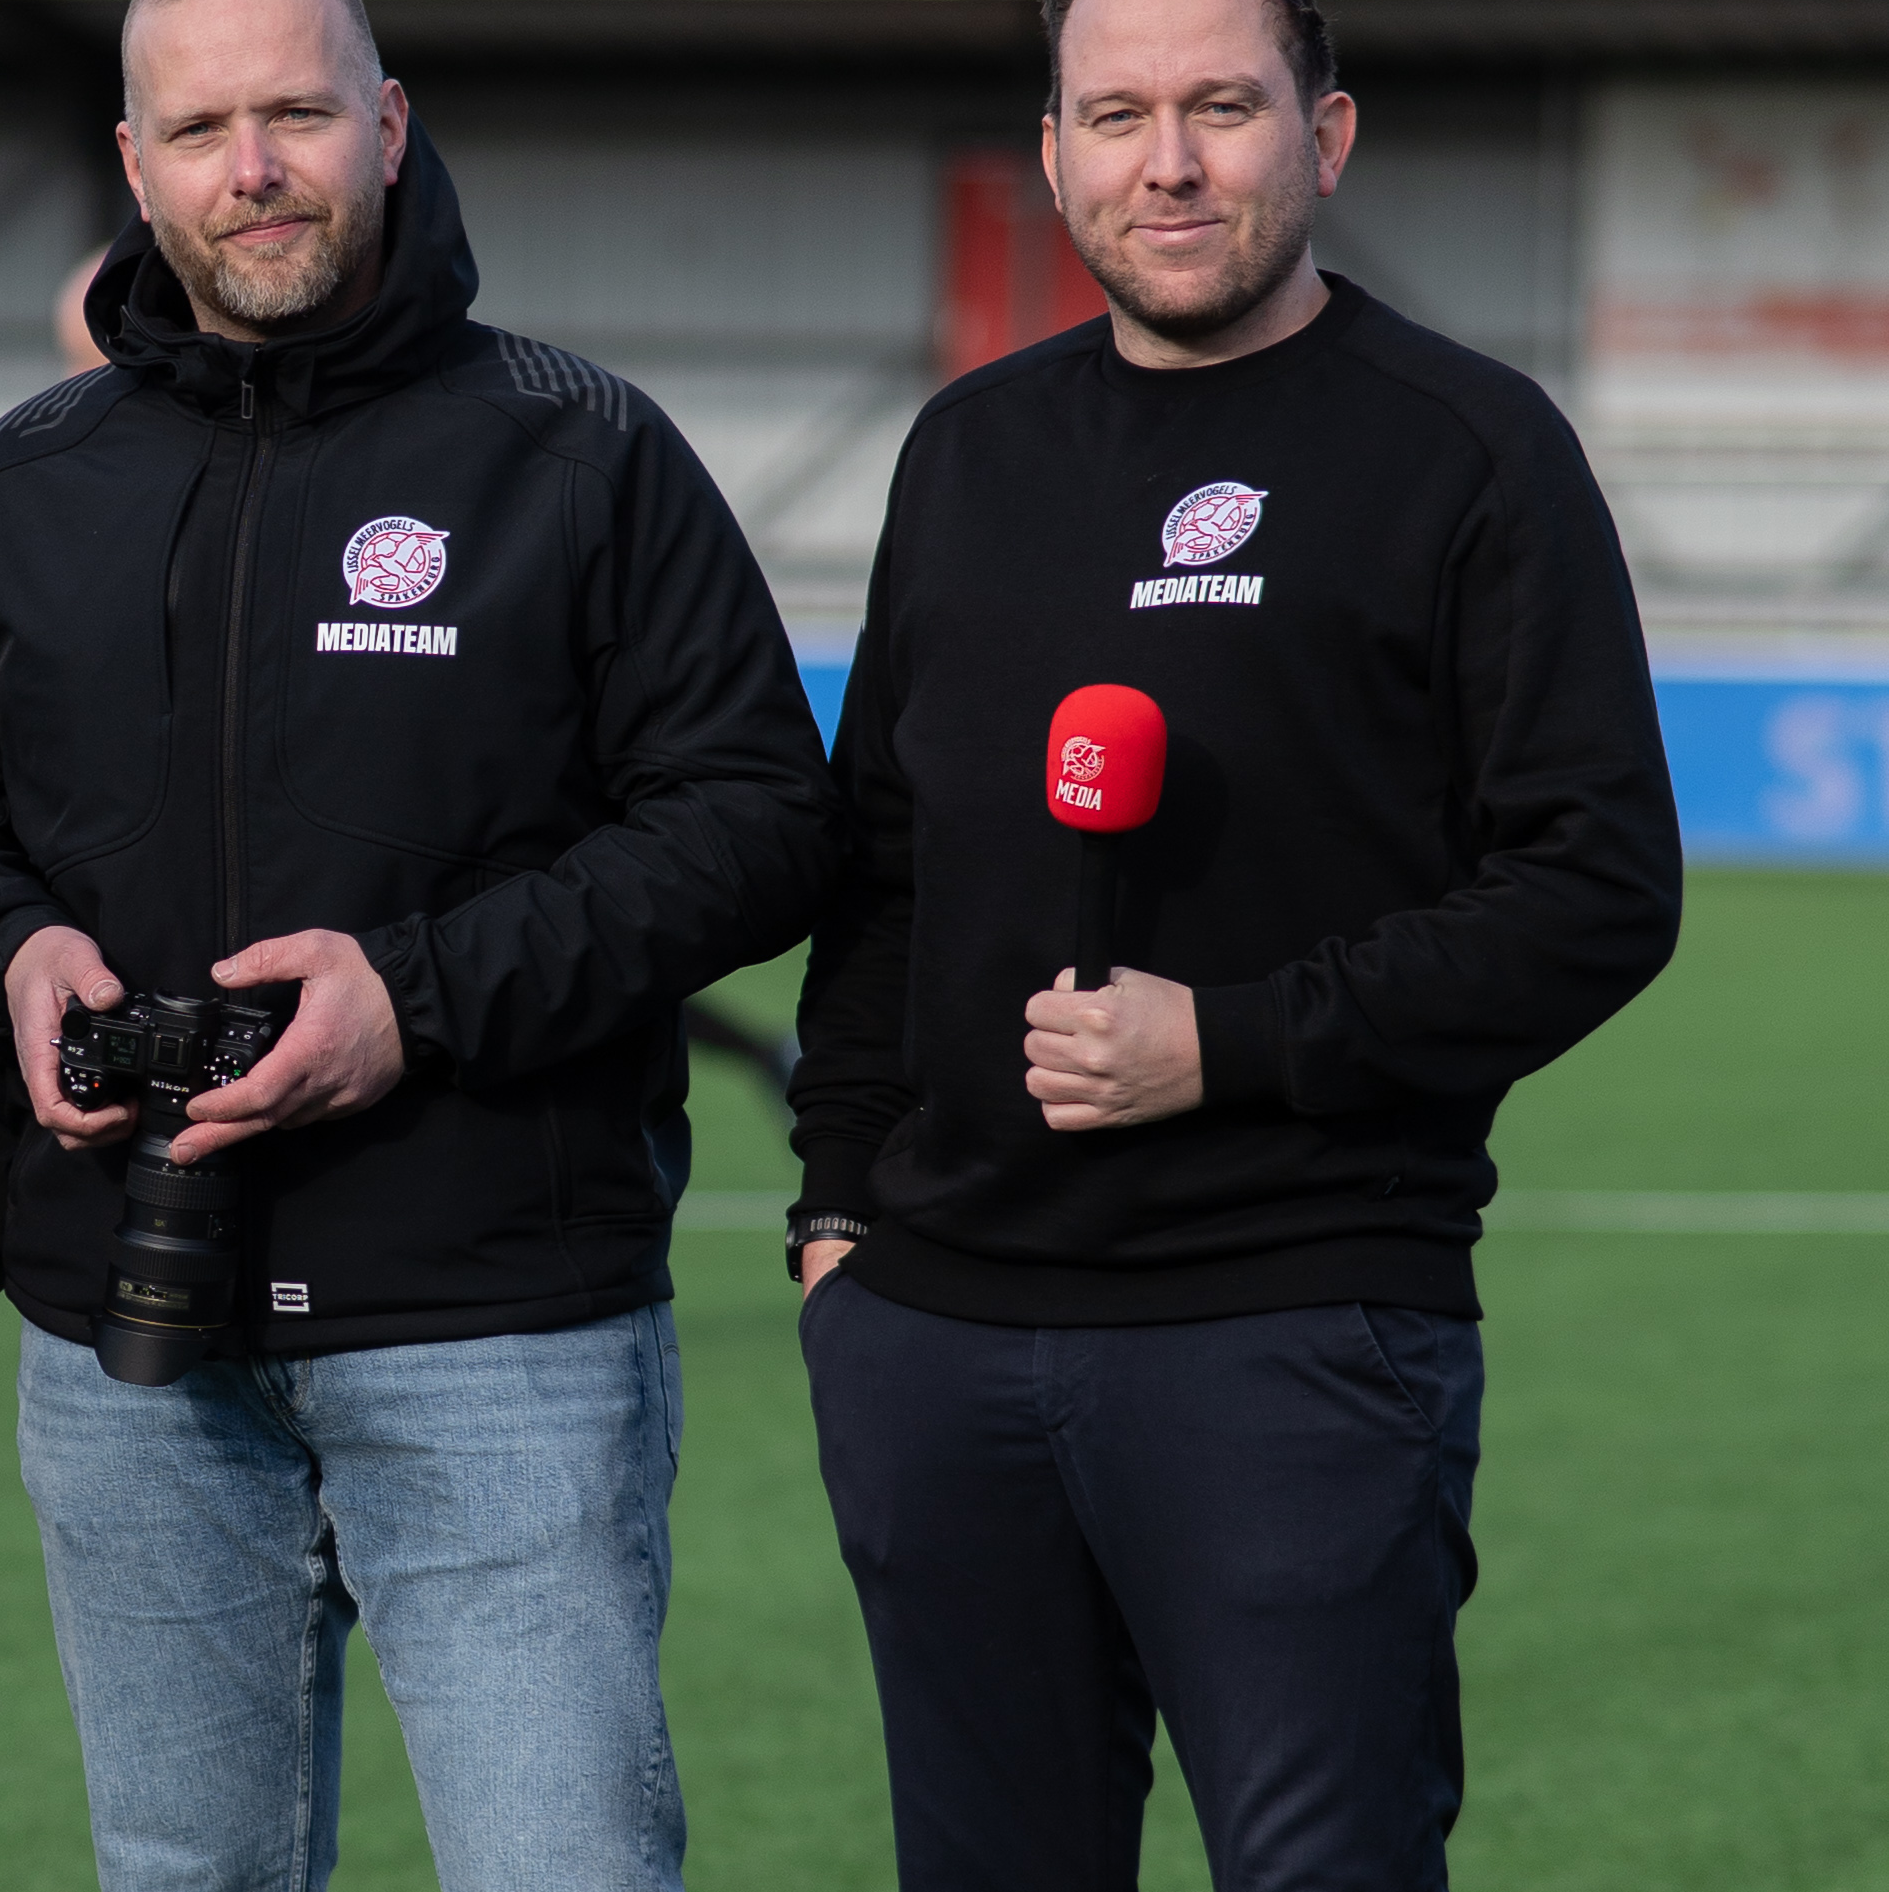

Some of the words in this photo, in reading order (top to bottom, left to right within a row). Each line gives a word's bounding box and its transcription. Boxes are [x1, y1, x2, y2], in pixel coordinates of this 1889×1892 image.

[1166, 484, 1237, 540] IJSSELMEERVOGELS
[347, 519, 415, 574] IJSSELMEERVOGELS
[379, 555, 441, 602] SPAKENBURG
[1129, 574, 1264, 610] MEDIATEAM
[316, 622, 458, 656] MEDIATEAM
[1055, 778, 1103, 811] MEDIA
[150, 1079, 190, 1094] Nikon
[271, 1292, 309, 1302] TRICORP
